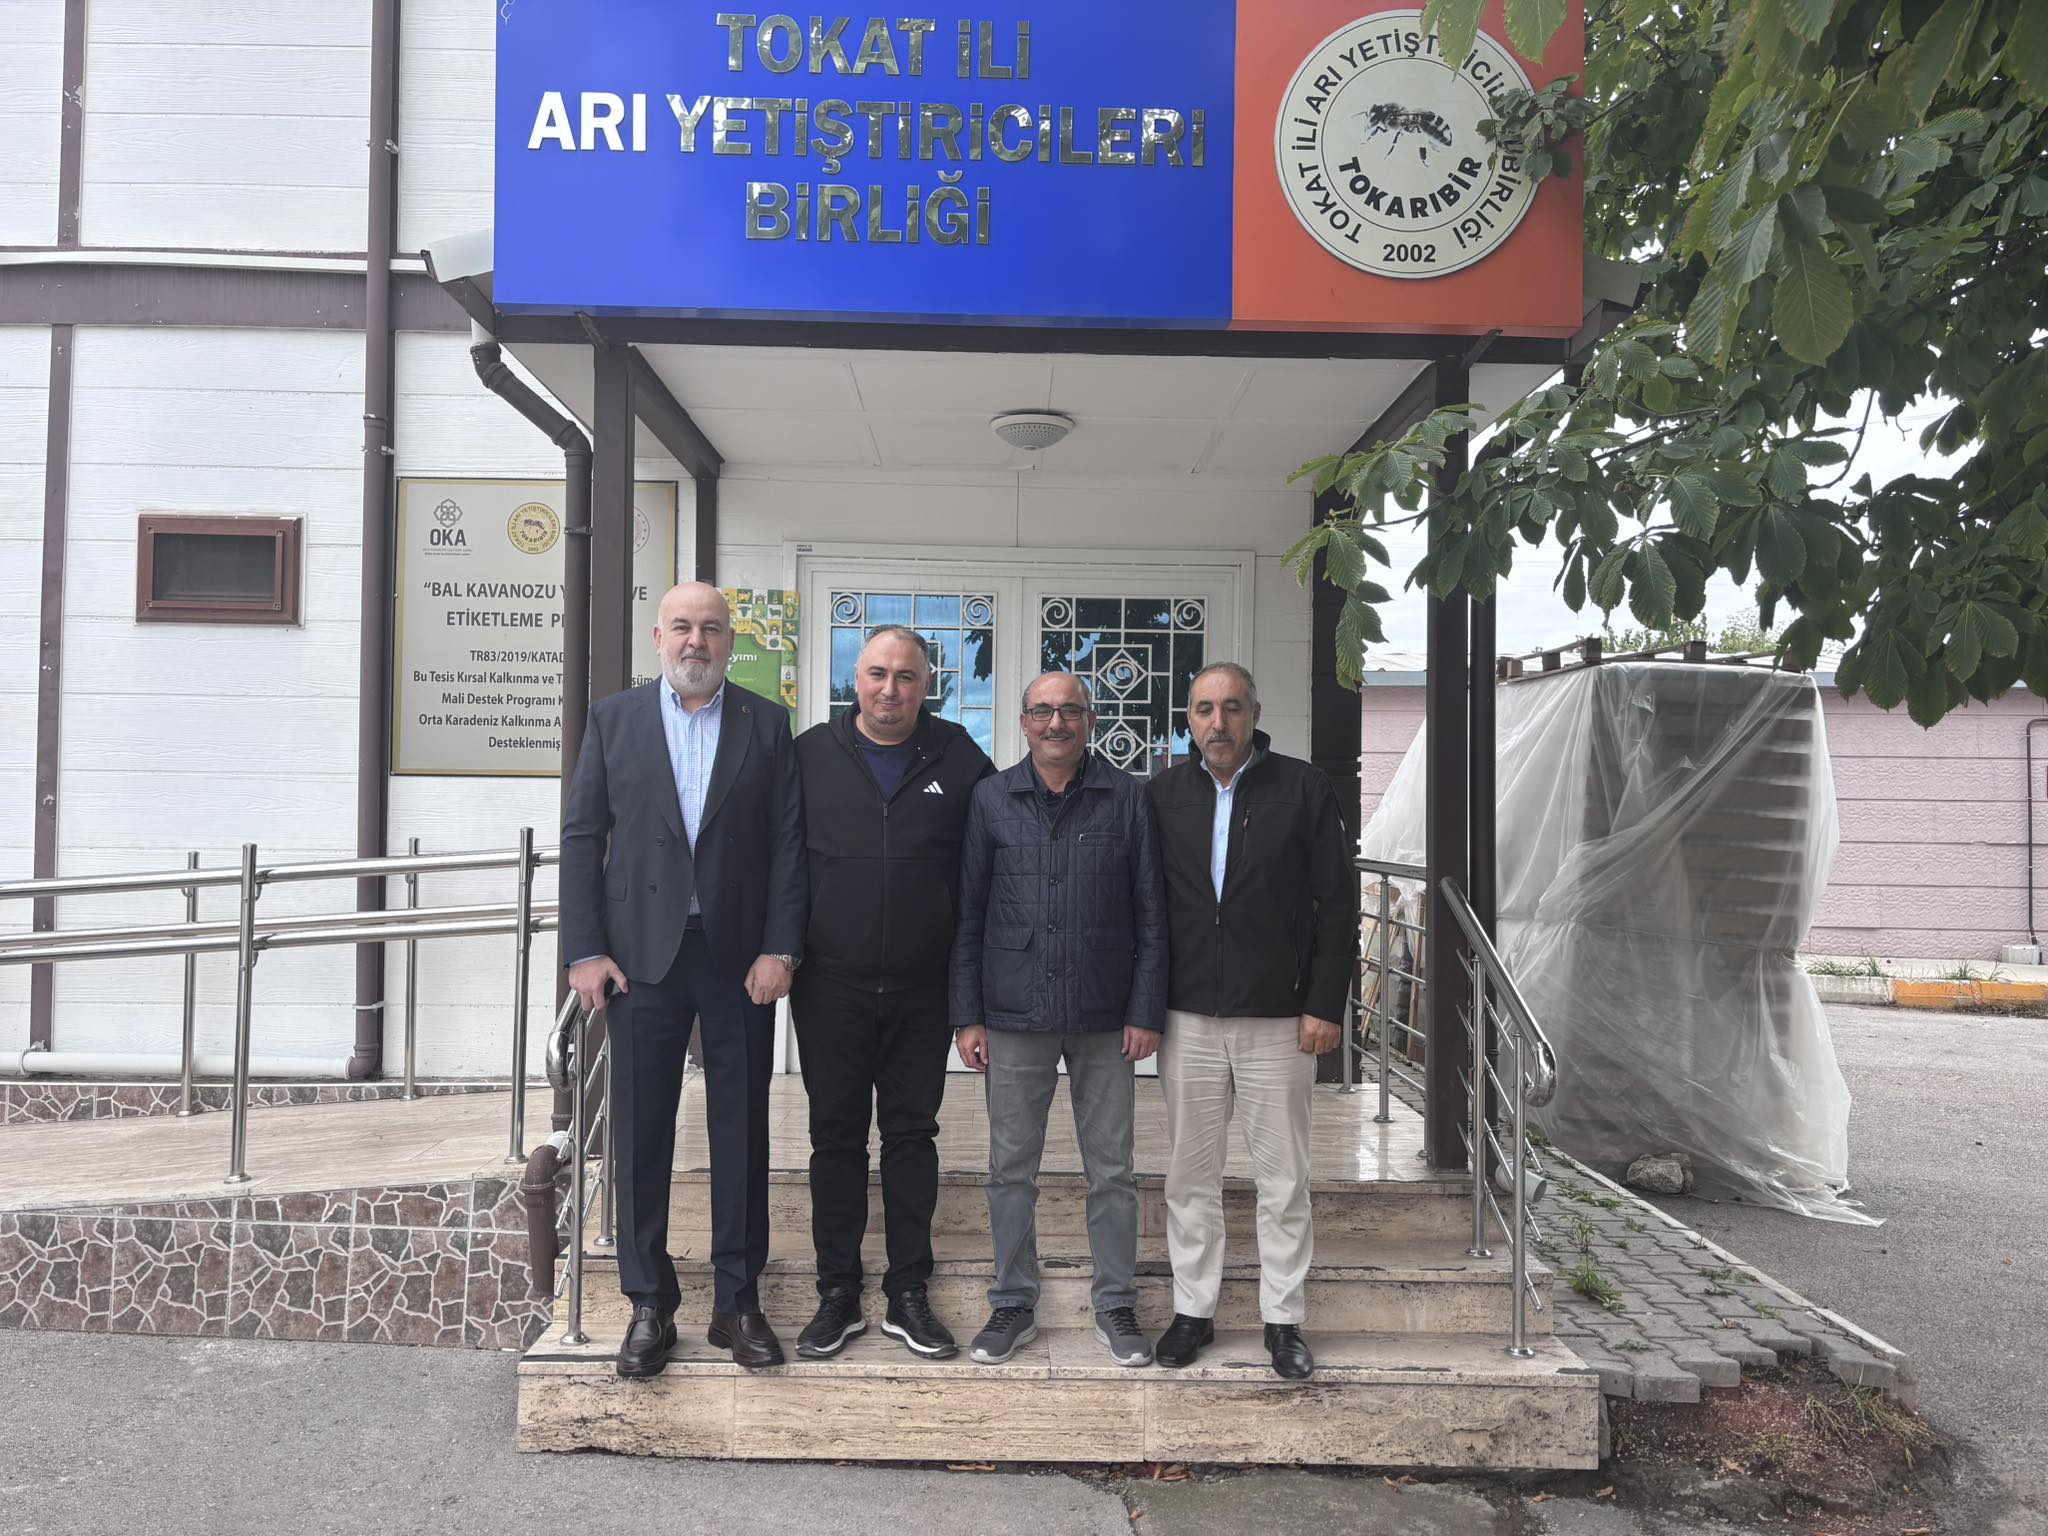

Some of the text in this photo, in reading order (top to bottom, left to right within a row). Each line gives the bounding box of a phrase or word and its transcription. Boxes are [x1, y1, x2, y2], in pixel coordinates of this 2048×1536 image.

[716, 13, 1030, 79] TOKAT İLİ
[1305, 65, 1343, 115] ARI
[527, 91, 1205, 175] ARI YETİŞTİRİCİLERİ
[1291, 117, 1318, 150] İLİ
[1338, 156, 1483, 219] TOKARIBİR
[745, 170, 990, 245] BİRLİĞİ
[1298, 163, 1362, 244] TOKAT
[1453, 154, 1522, 249] BİRLİĞİ
[1382, 244, 1436, 263] 2002
[430, 528, 466, 546] OKA
[466, 583, 556, 599] KAVANOZU
[446, 608, 543, 628] ETİKETLEME
[413, 671, 428, 682] Bu
[429, 671, 455, 683] Tesis
[457, 671, 487, 683] Kırsal
[489, 671, 540, 684] Kalkınma
[542, 675, 555, 685] ve
[442, 693, 465, 705] Mali
[467, 693, 504, 705] Destek
[506, 694, 555, 708] Programı
[419, 714, 443, 726] Orta
[445, 714, 499, 726] Karadeniz
[501, 715, 551, 727] Kalkınma
[488, 736, 562, 751] Desteklenmiş
